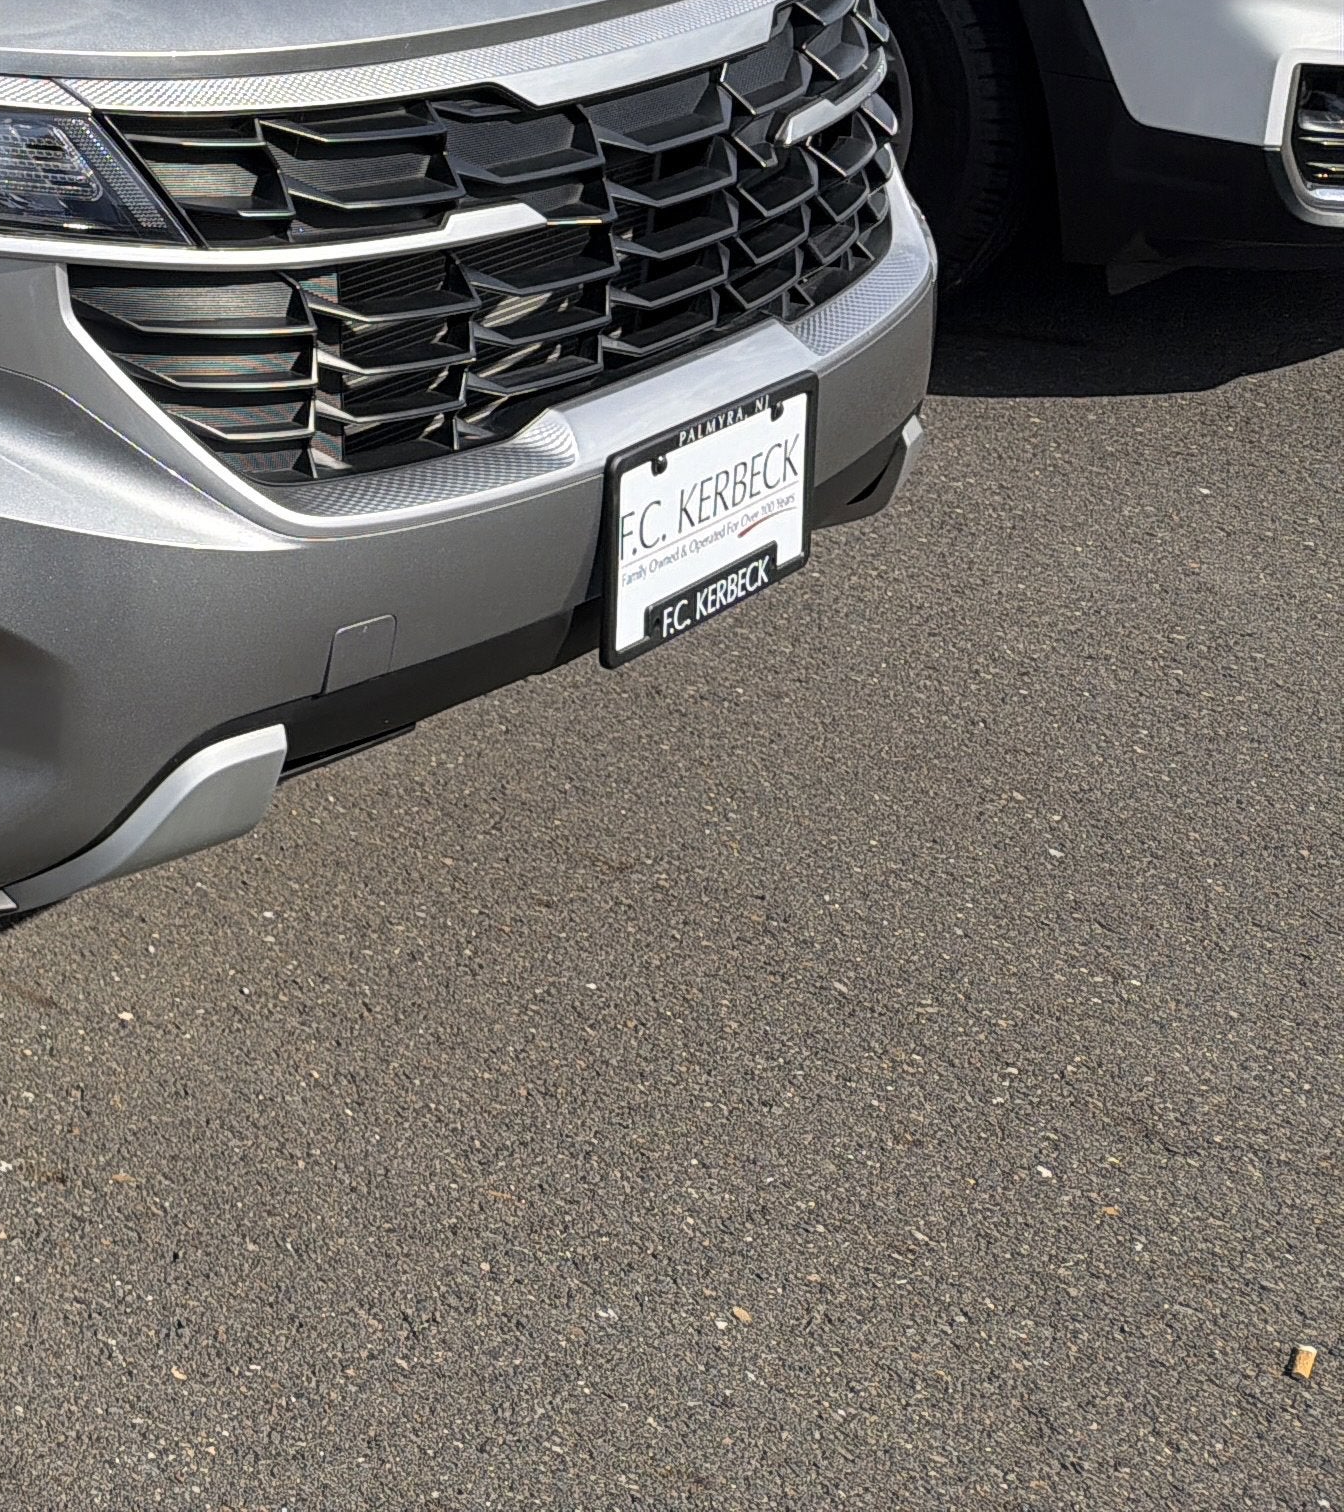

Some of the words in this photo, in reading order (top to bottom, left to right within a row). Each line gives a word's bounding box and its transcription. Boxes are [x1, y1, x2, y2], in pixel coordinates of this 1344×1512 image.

[678, 406, 748, 448] PALMYRA,
[618, 500, 666, 561] F.C.
[677, 433, 800, 534] KERBECK
[649, 547, 680, 573] Owned
[689, 528, 725, 555] Operated
[727, 520, 738, 536] For
[740, 509, 760, 529] Over
[662, 598, 691, 638] F.C.
[695, 555, 770, 620] KERBECK
